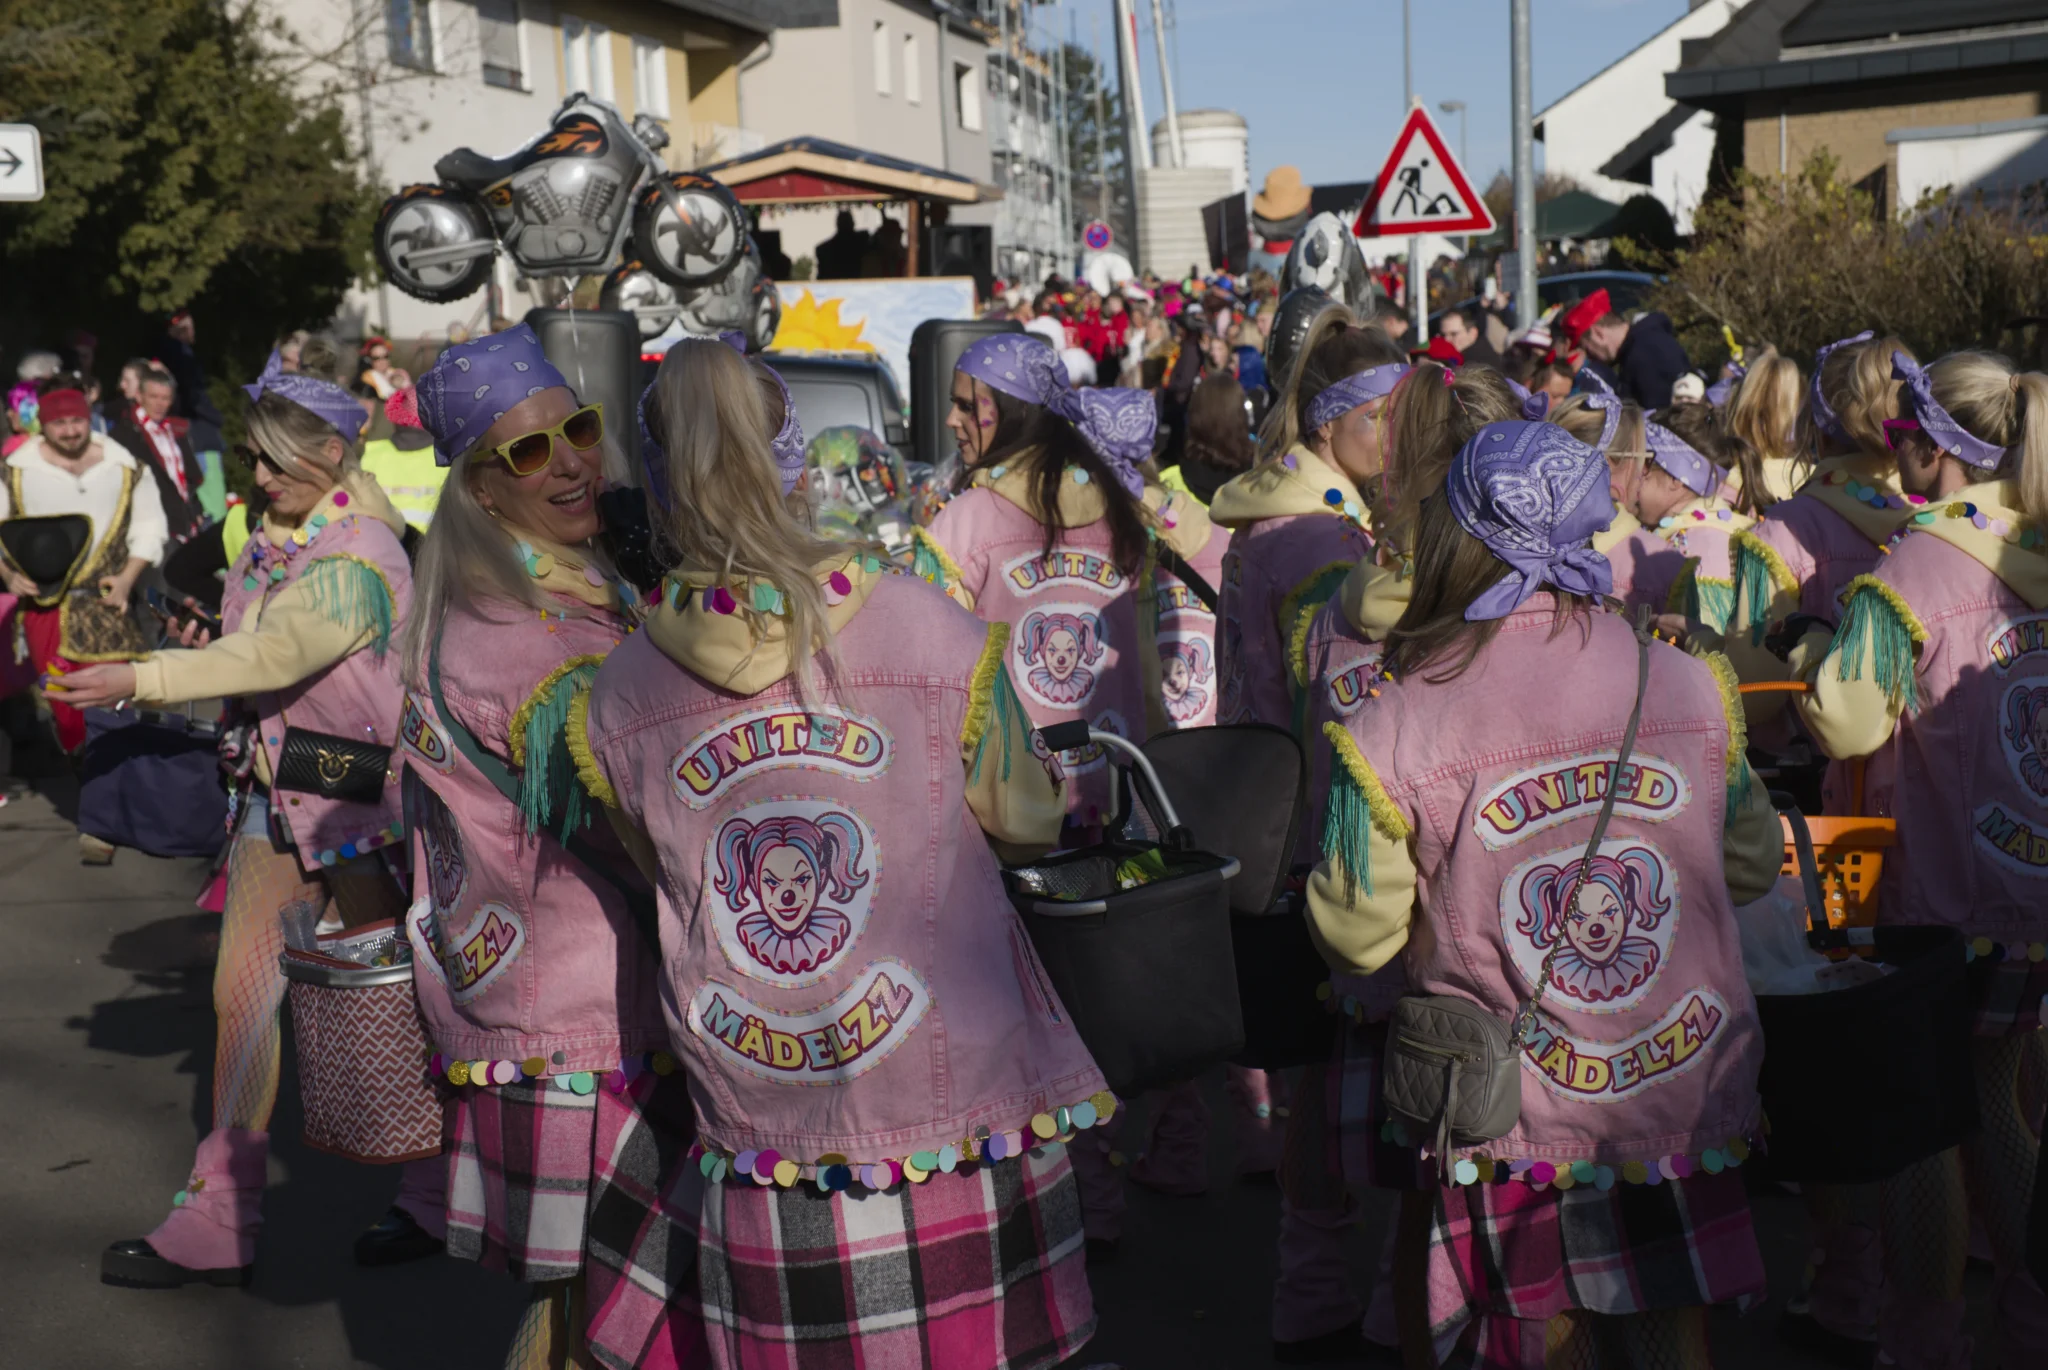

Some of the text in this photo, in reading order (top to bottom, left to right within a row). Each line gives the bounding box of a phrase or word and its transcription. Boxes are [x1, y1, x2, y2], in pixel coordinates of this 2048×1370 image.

[1009, 552, 1122, 590] UNITED
[677, 711, 884, 796] UNITED
[1480, 760, 1678, 835] UNITED
[701, 971, 914, 1072] MÄDELZZ
[1520, 995, 1722, 1094] MÄDELZZ
